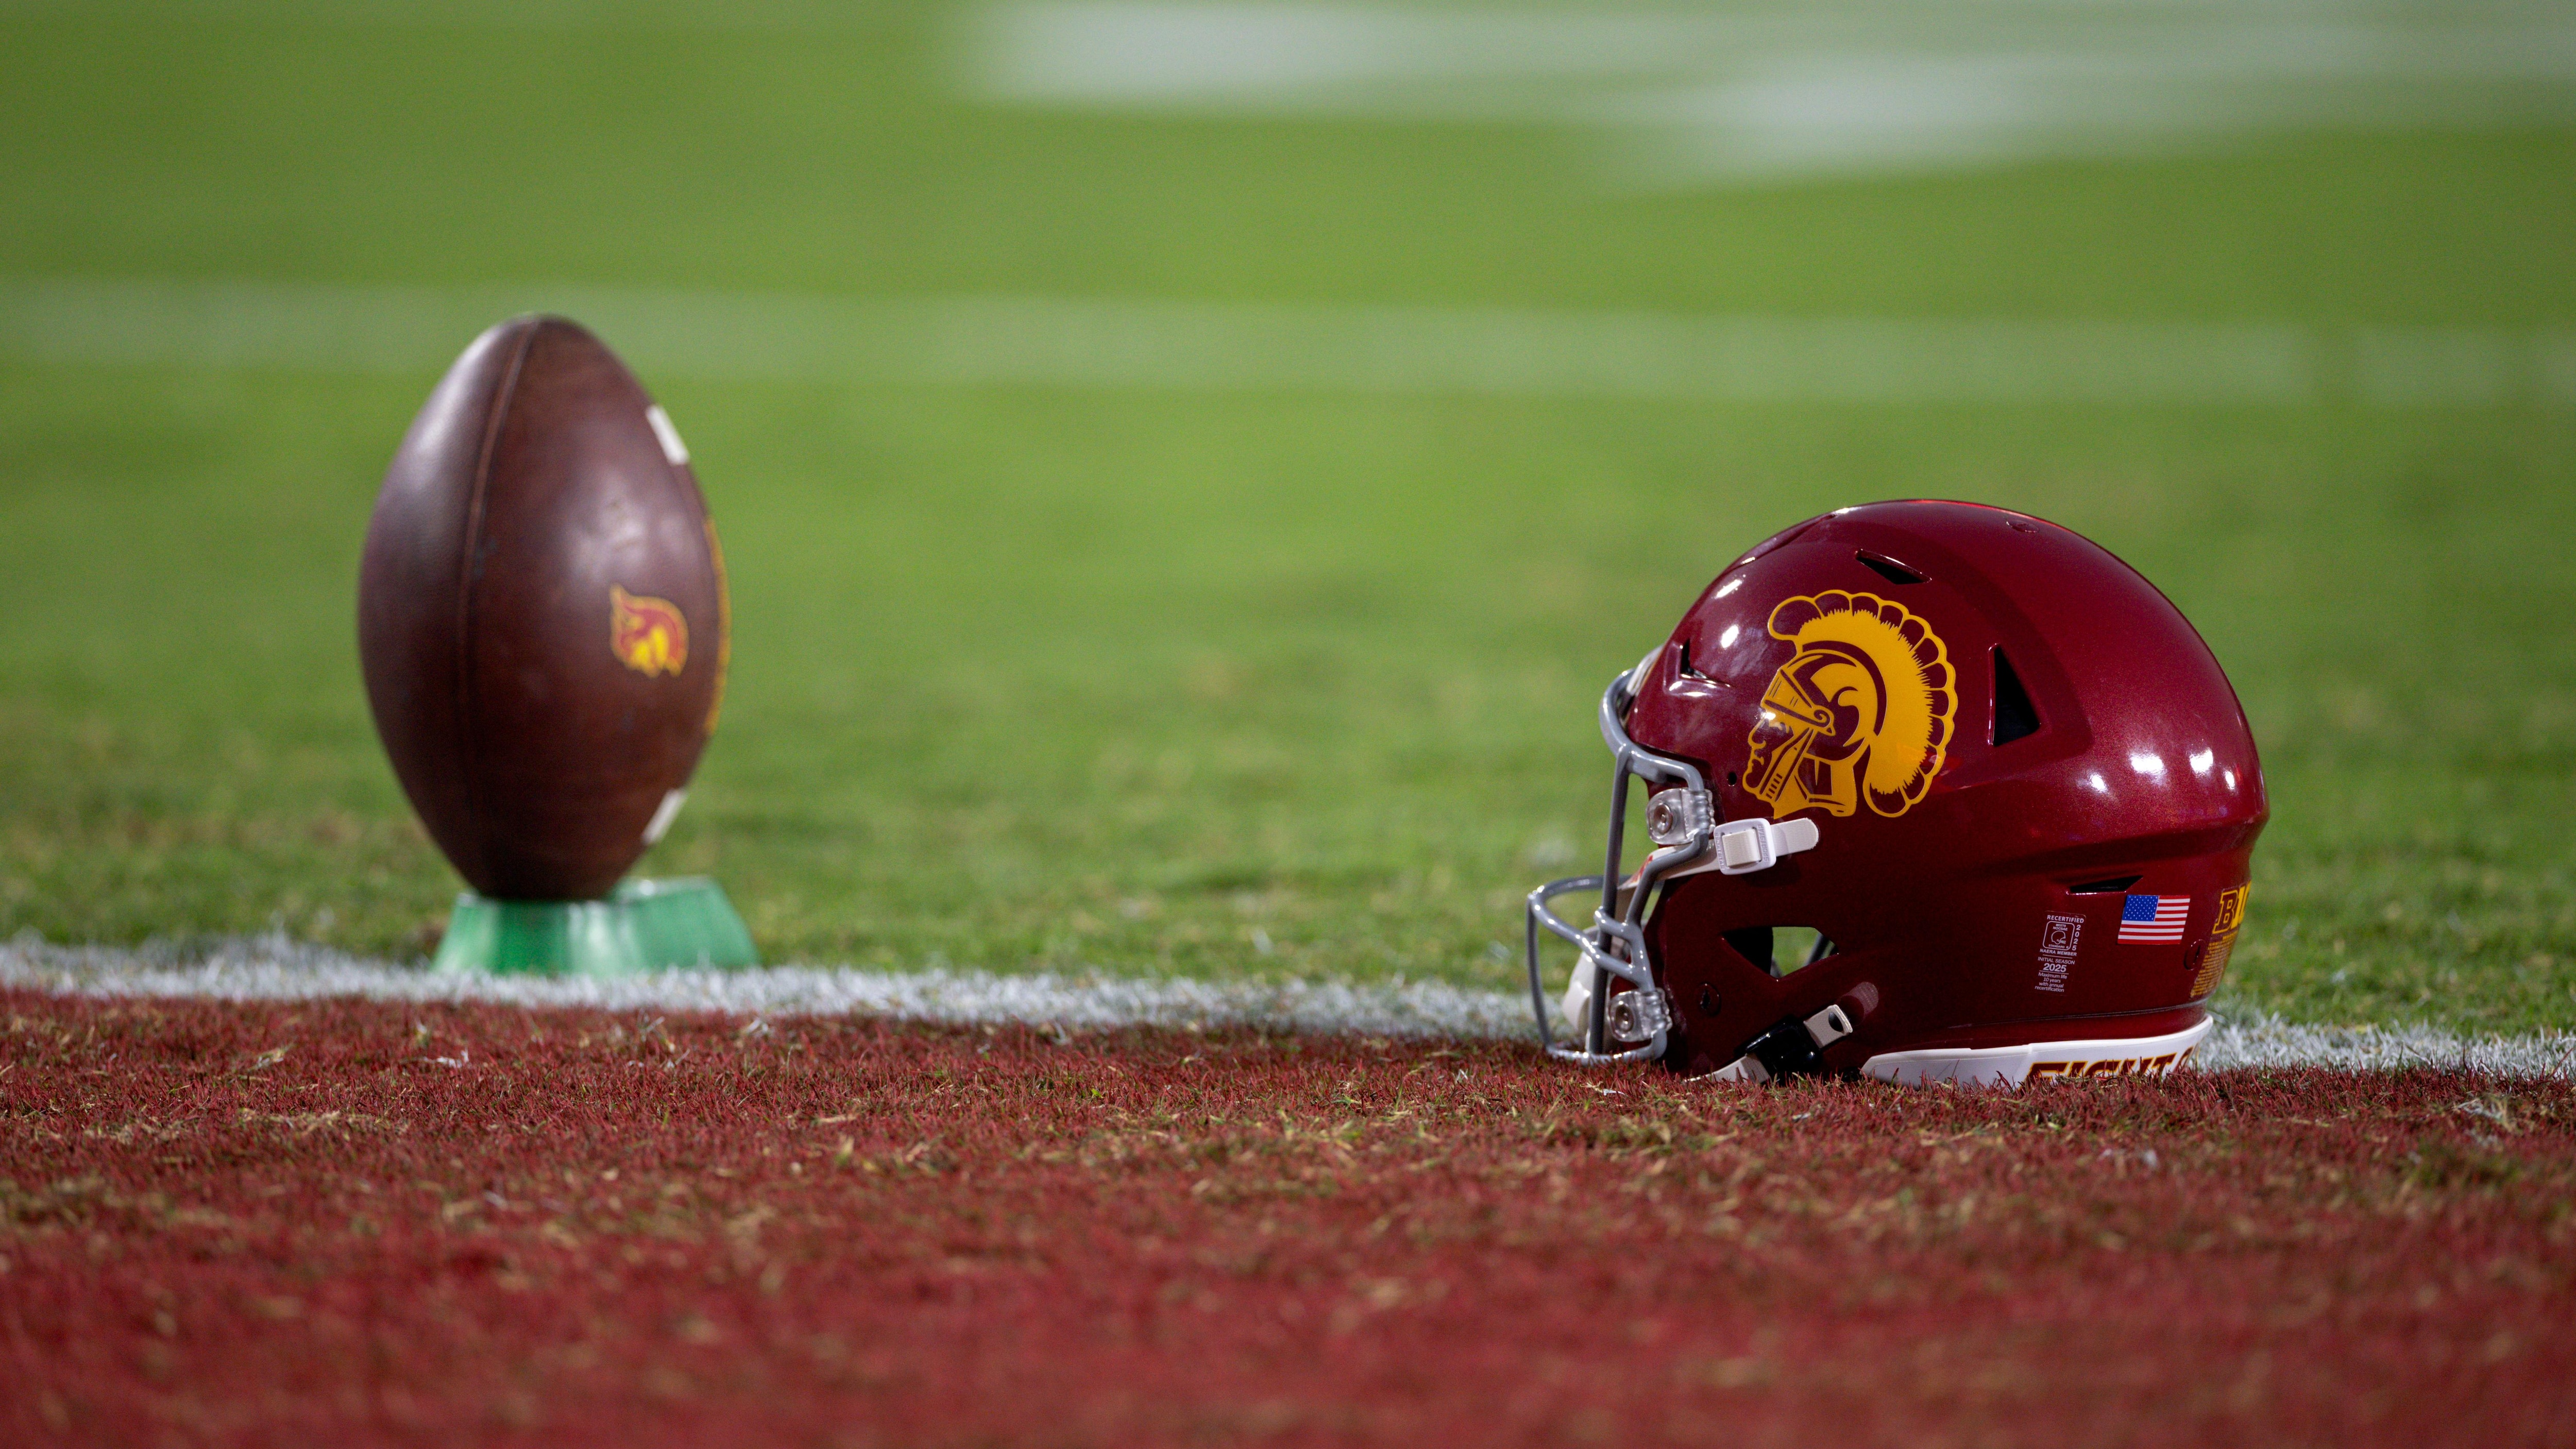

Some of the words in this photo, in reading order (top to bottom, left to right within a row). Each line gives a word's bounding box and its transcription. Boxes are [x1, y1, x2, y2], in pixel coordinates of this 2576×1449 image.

[1757, 824, 1769, 862] SPORTSTAR
[2047, 915, 2084, 923] RECERTIFIED
[2043, 963, 2067, 973] 2025
